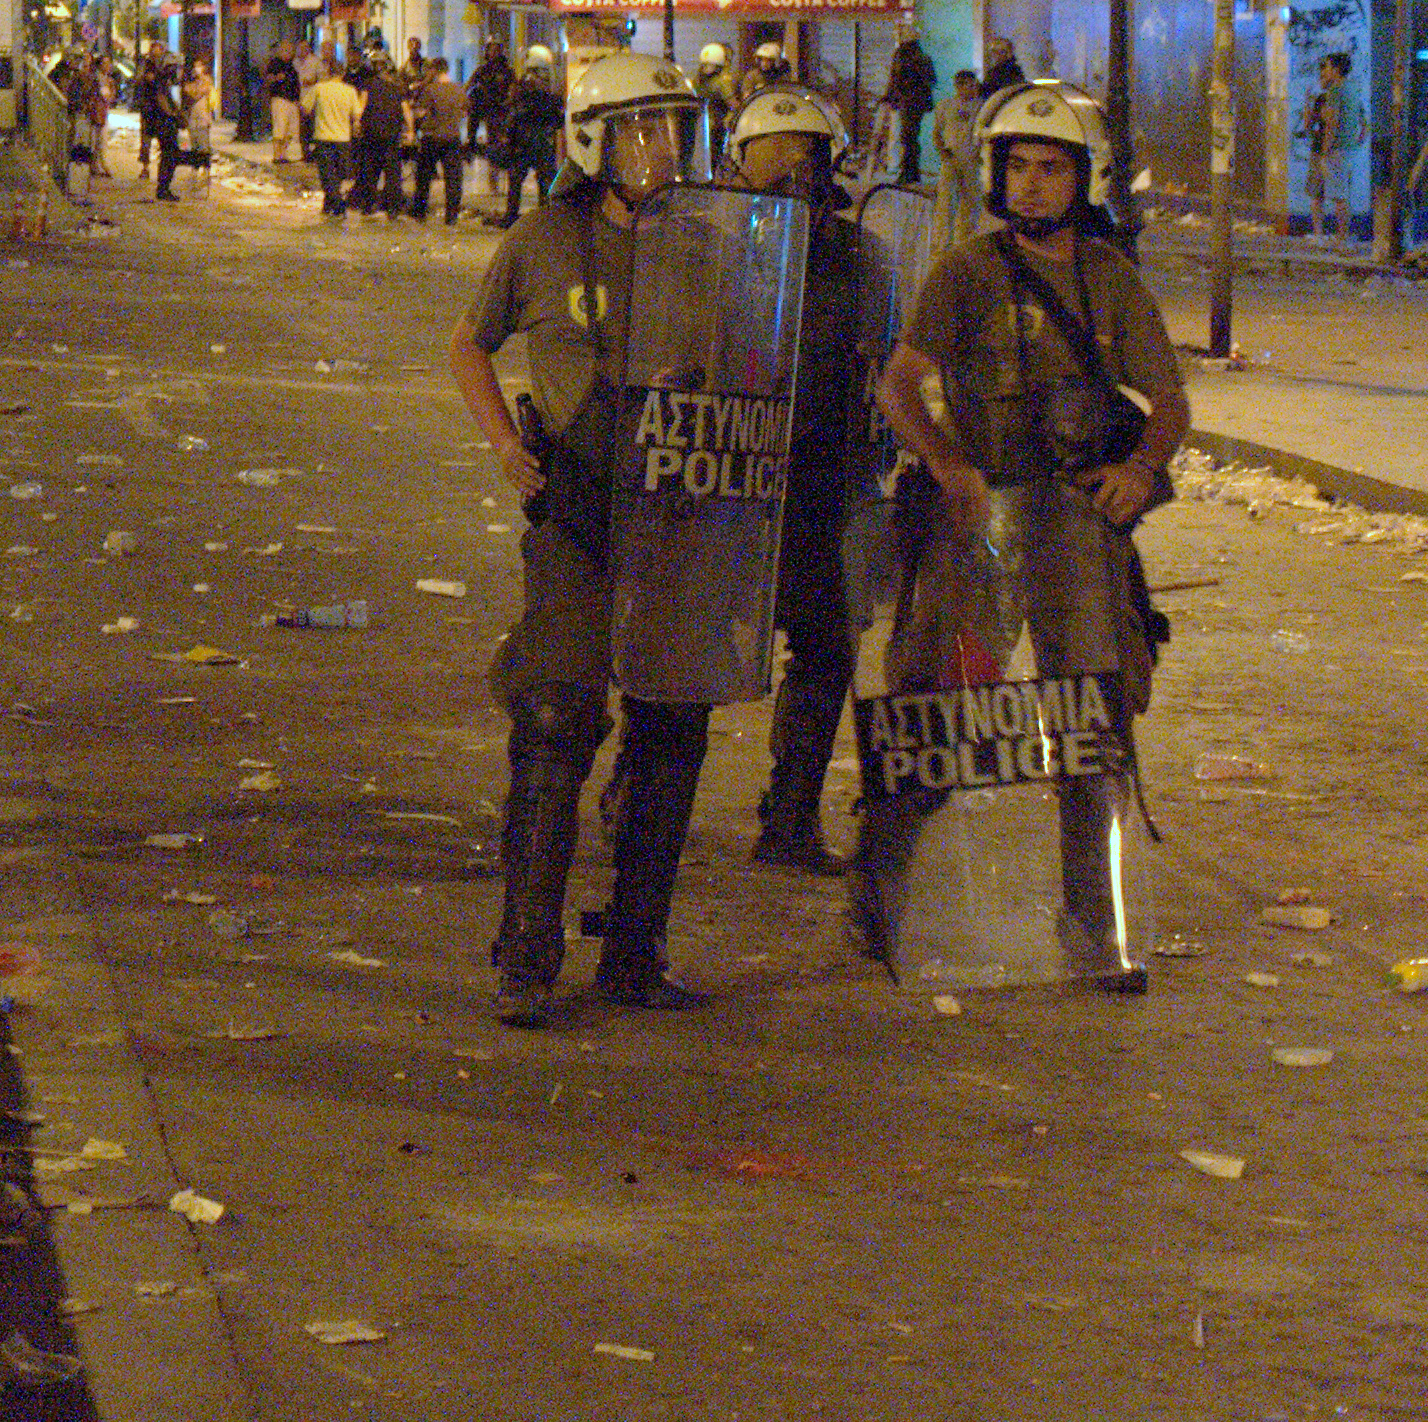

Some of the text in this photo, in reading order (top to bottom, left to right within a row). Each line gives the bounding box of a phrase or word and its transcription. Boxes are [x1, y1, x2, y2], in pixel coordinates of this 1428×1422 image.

[644, 446, 788, 499] POLICE
[871, 676, 1111, 752] ΑΣΤΥΝΟΜΙΑ
[883, 730, 1103, 794] POLICE
